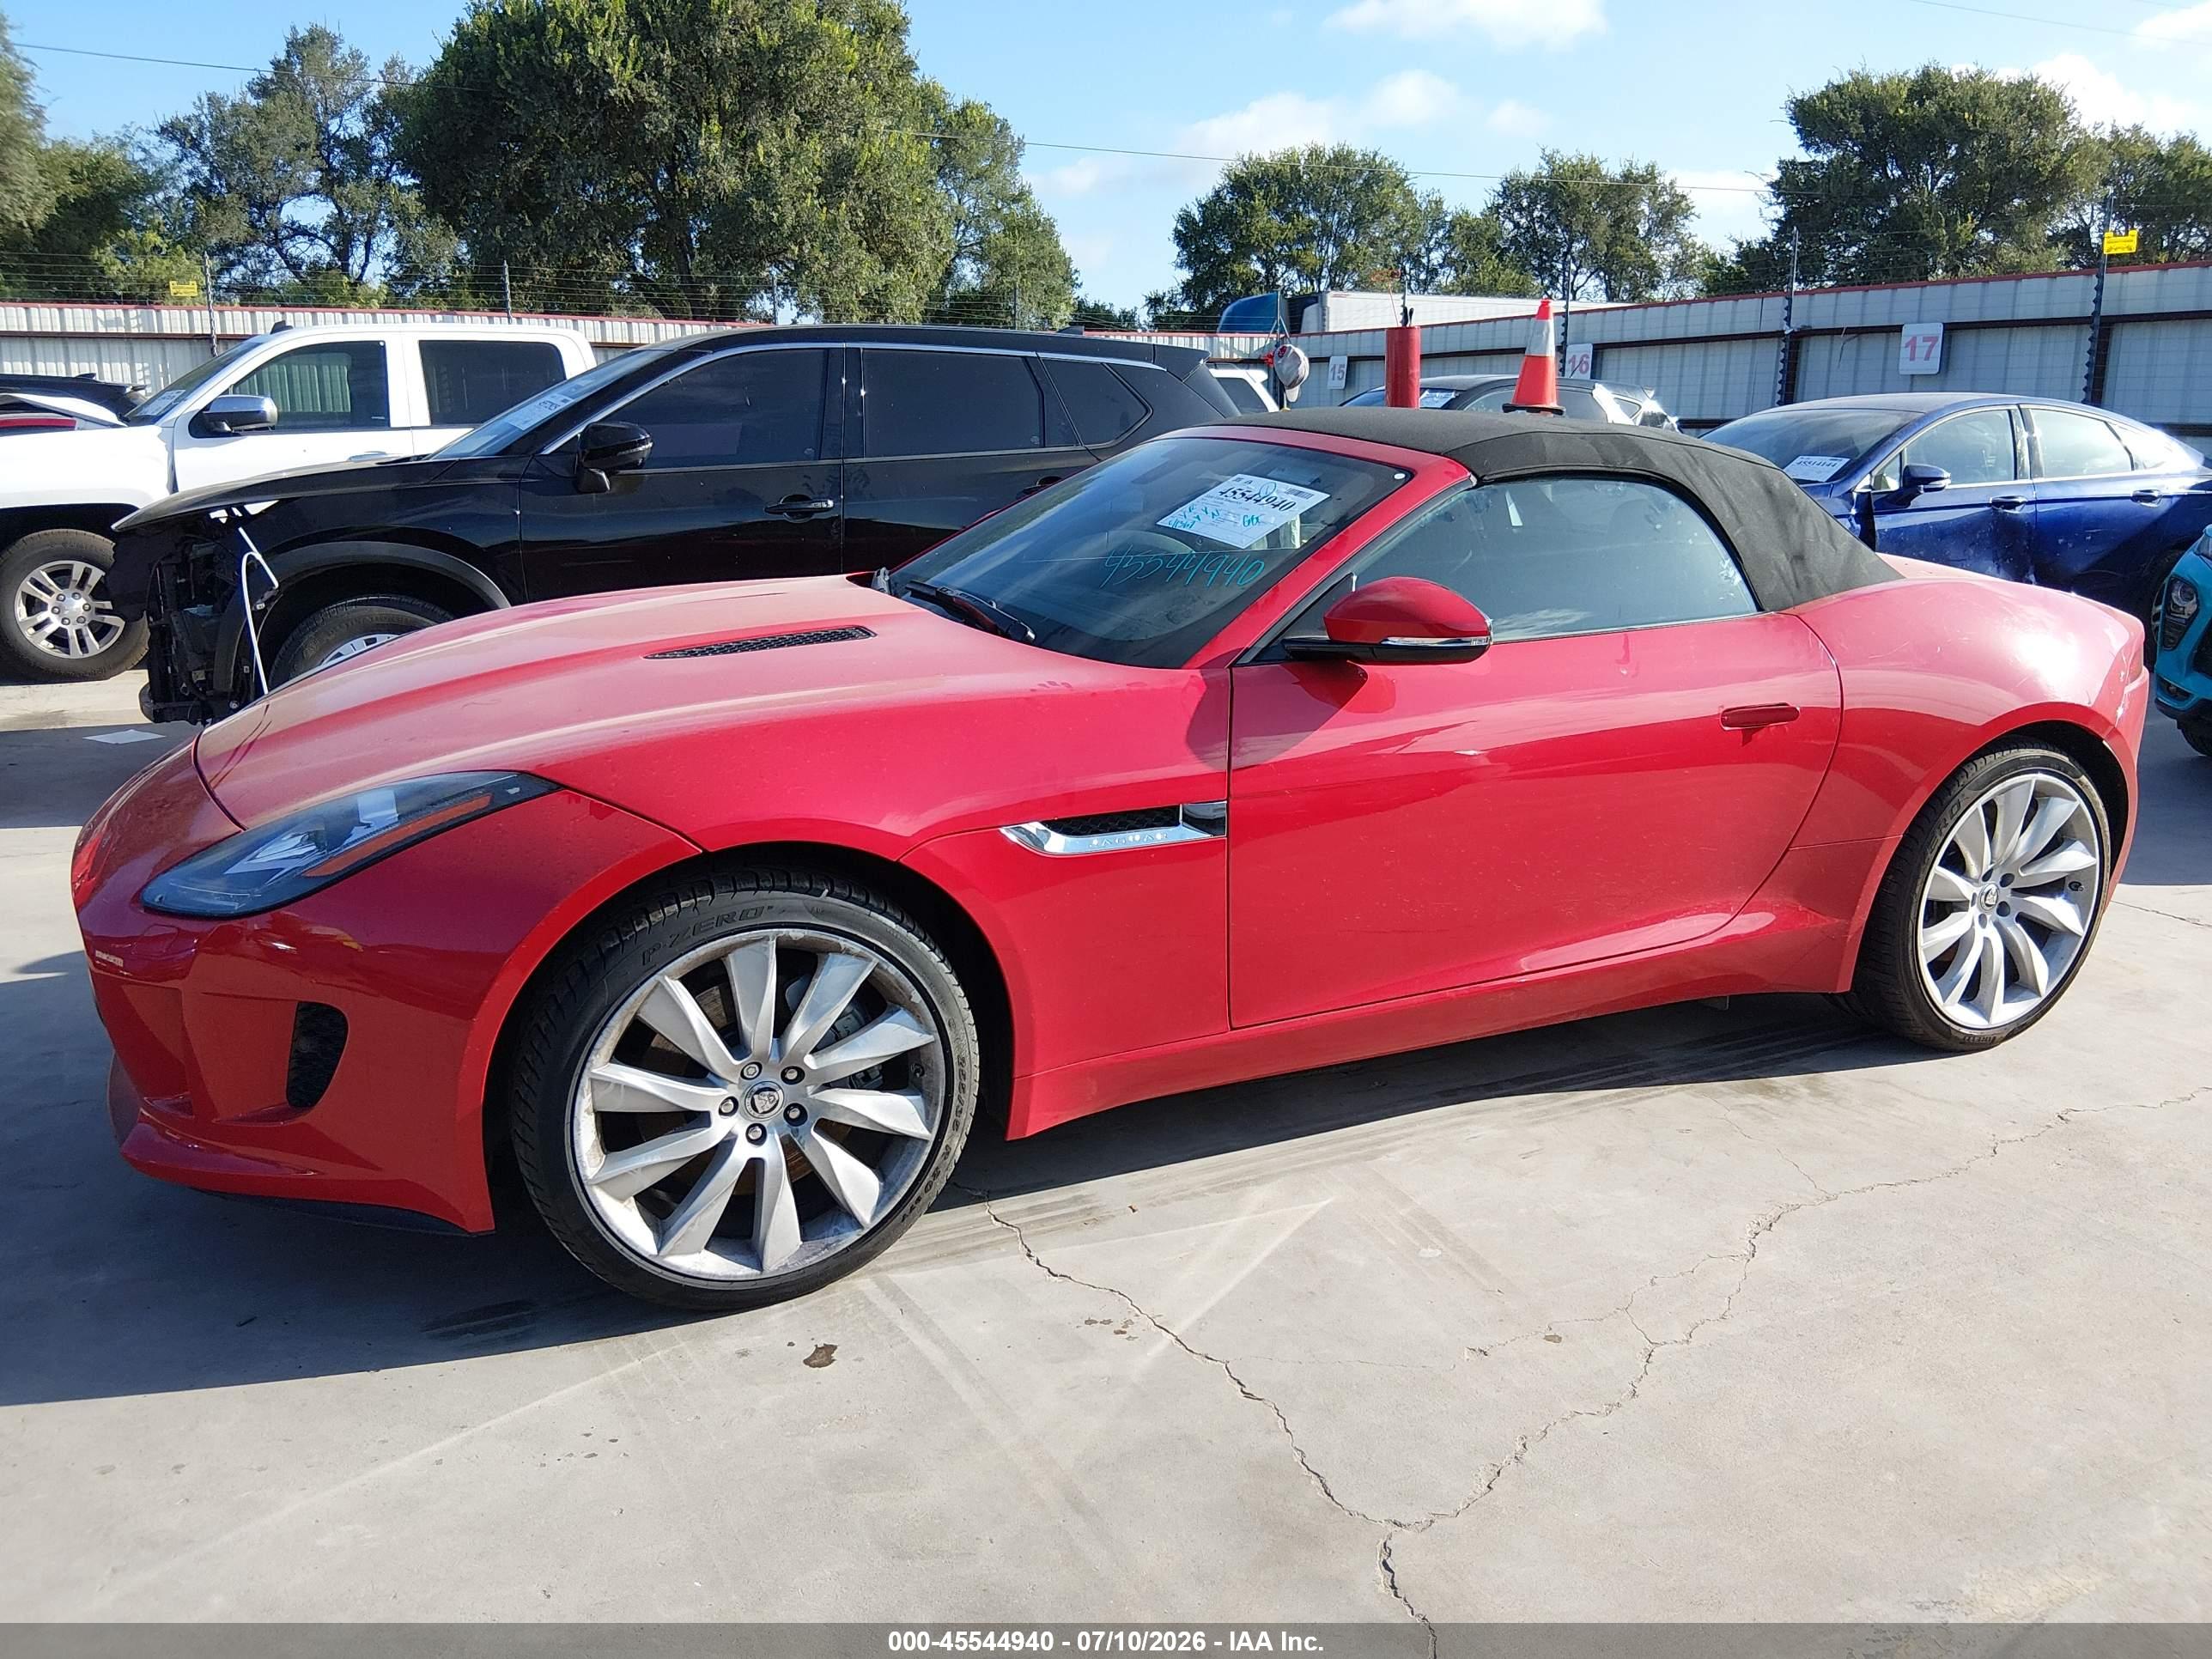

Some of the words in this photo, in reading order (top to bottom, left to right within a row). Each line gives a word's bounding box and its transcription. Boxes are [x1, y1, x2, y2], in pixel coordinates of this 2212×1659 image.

[1905, 336, 1938, 362] 17
[1331, 363, 1346, 380] 15
[1569, 353, 1589, 374] 16
[1218, 486, 1297, 512] 45544940
[1099, 544, 1265, 589] 45544940
[669, 904, 765, 948] ZERO
